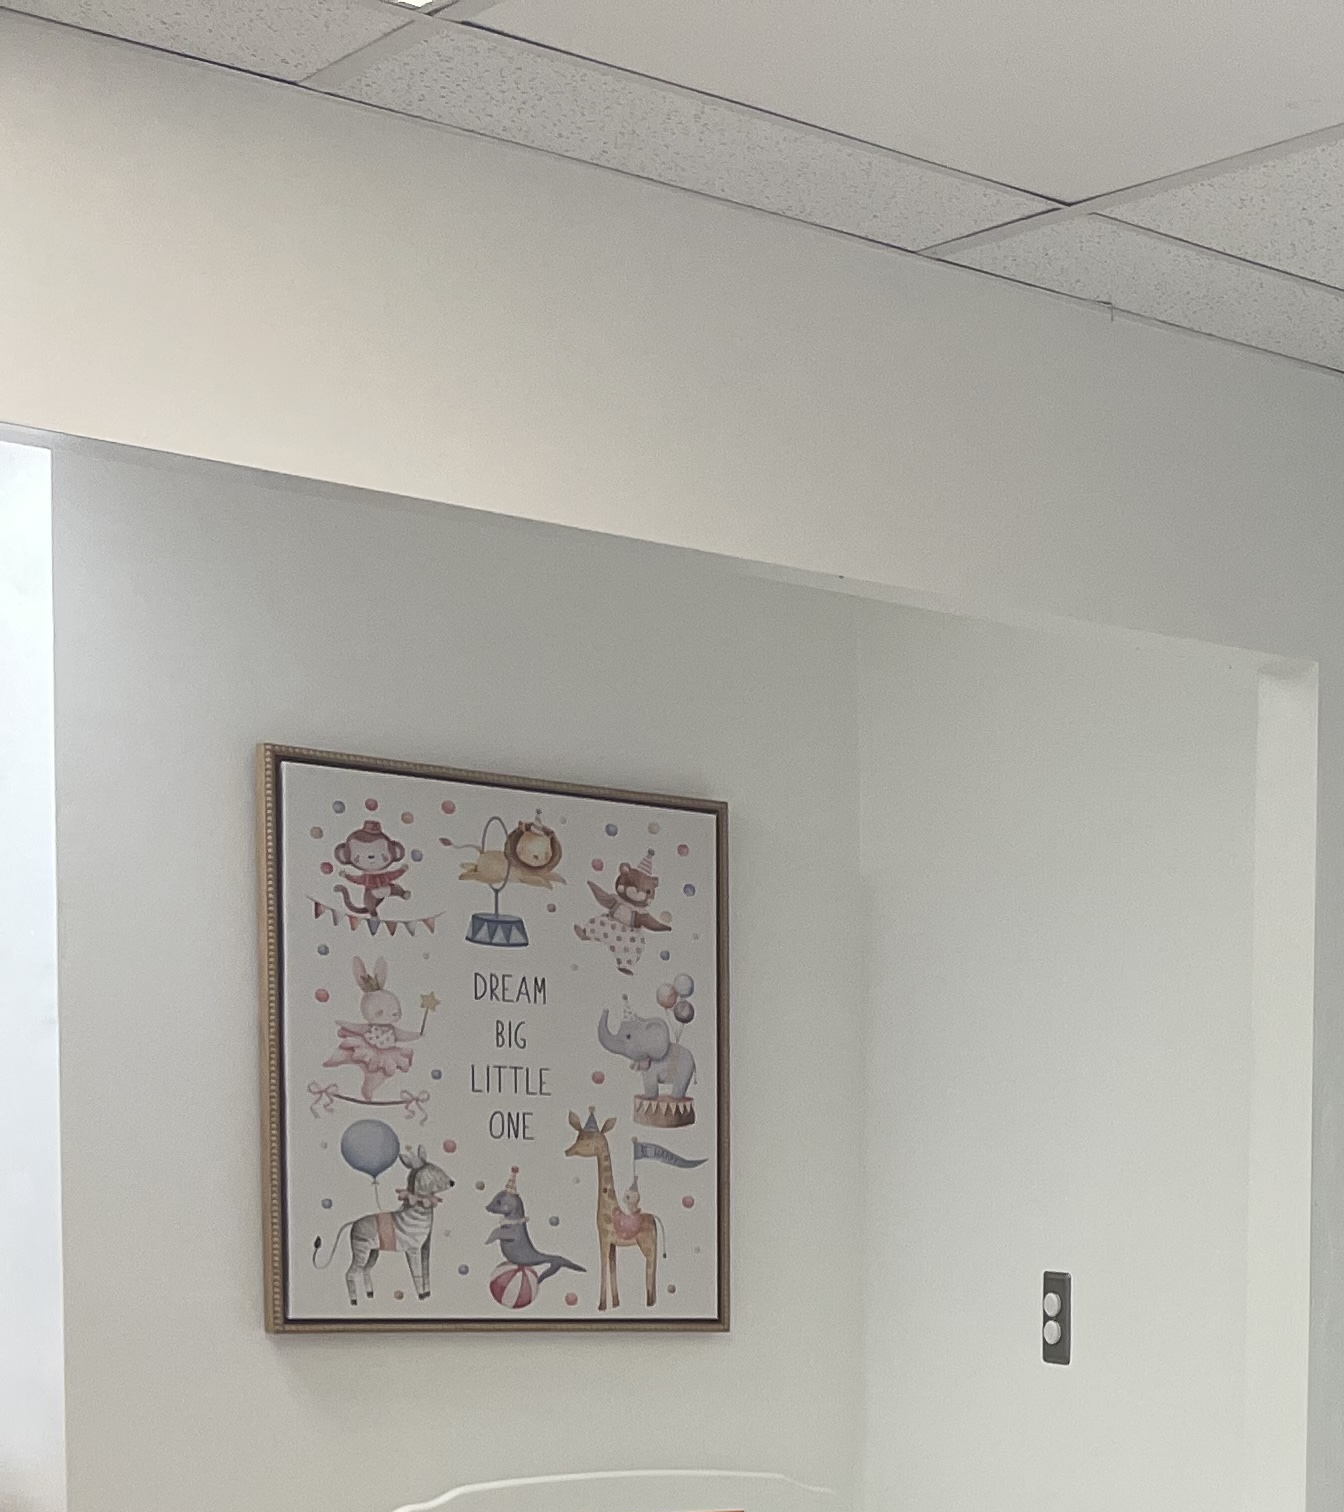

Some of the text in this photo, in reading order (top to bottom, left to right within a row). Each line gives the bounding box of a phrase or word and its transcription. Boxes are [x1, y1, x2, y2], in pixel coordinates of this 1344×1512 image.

[474, 972, 546, 1005] DREAM
[496, 1019, 526, 1049] BIG
[471, 1064, 552, 1096] LITTLE
[489, 1110, 534, 1141] ONE
